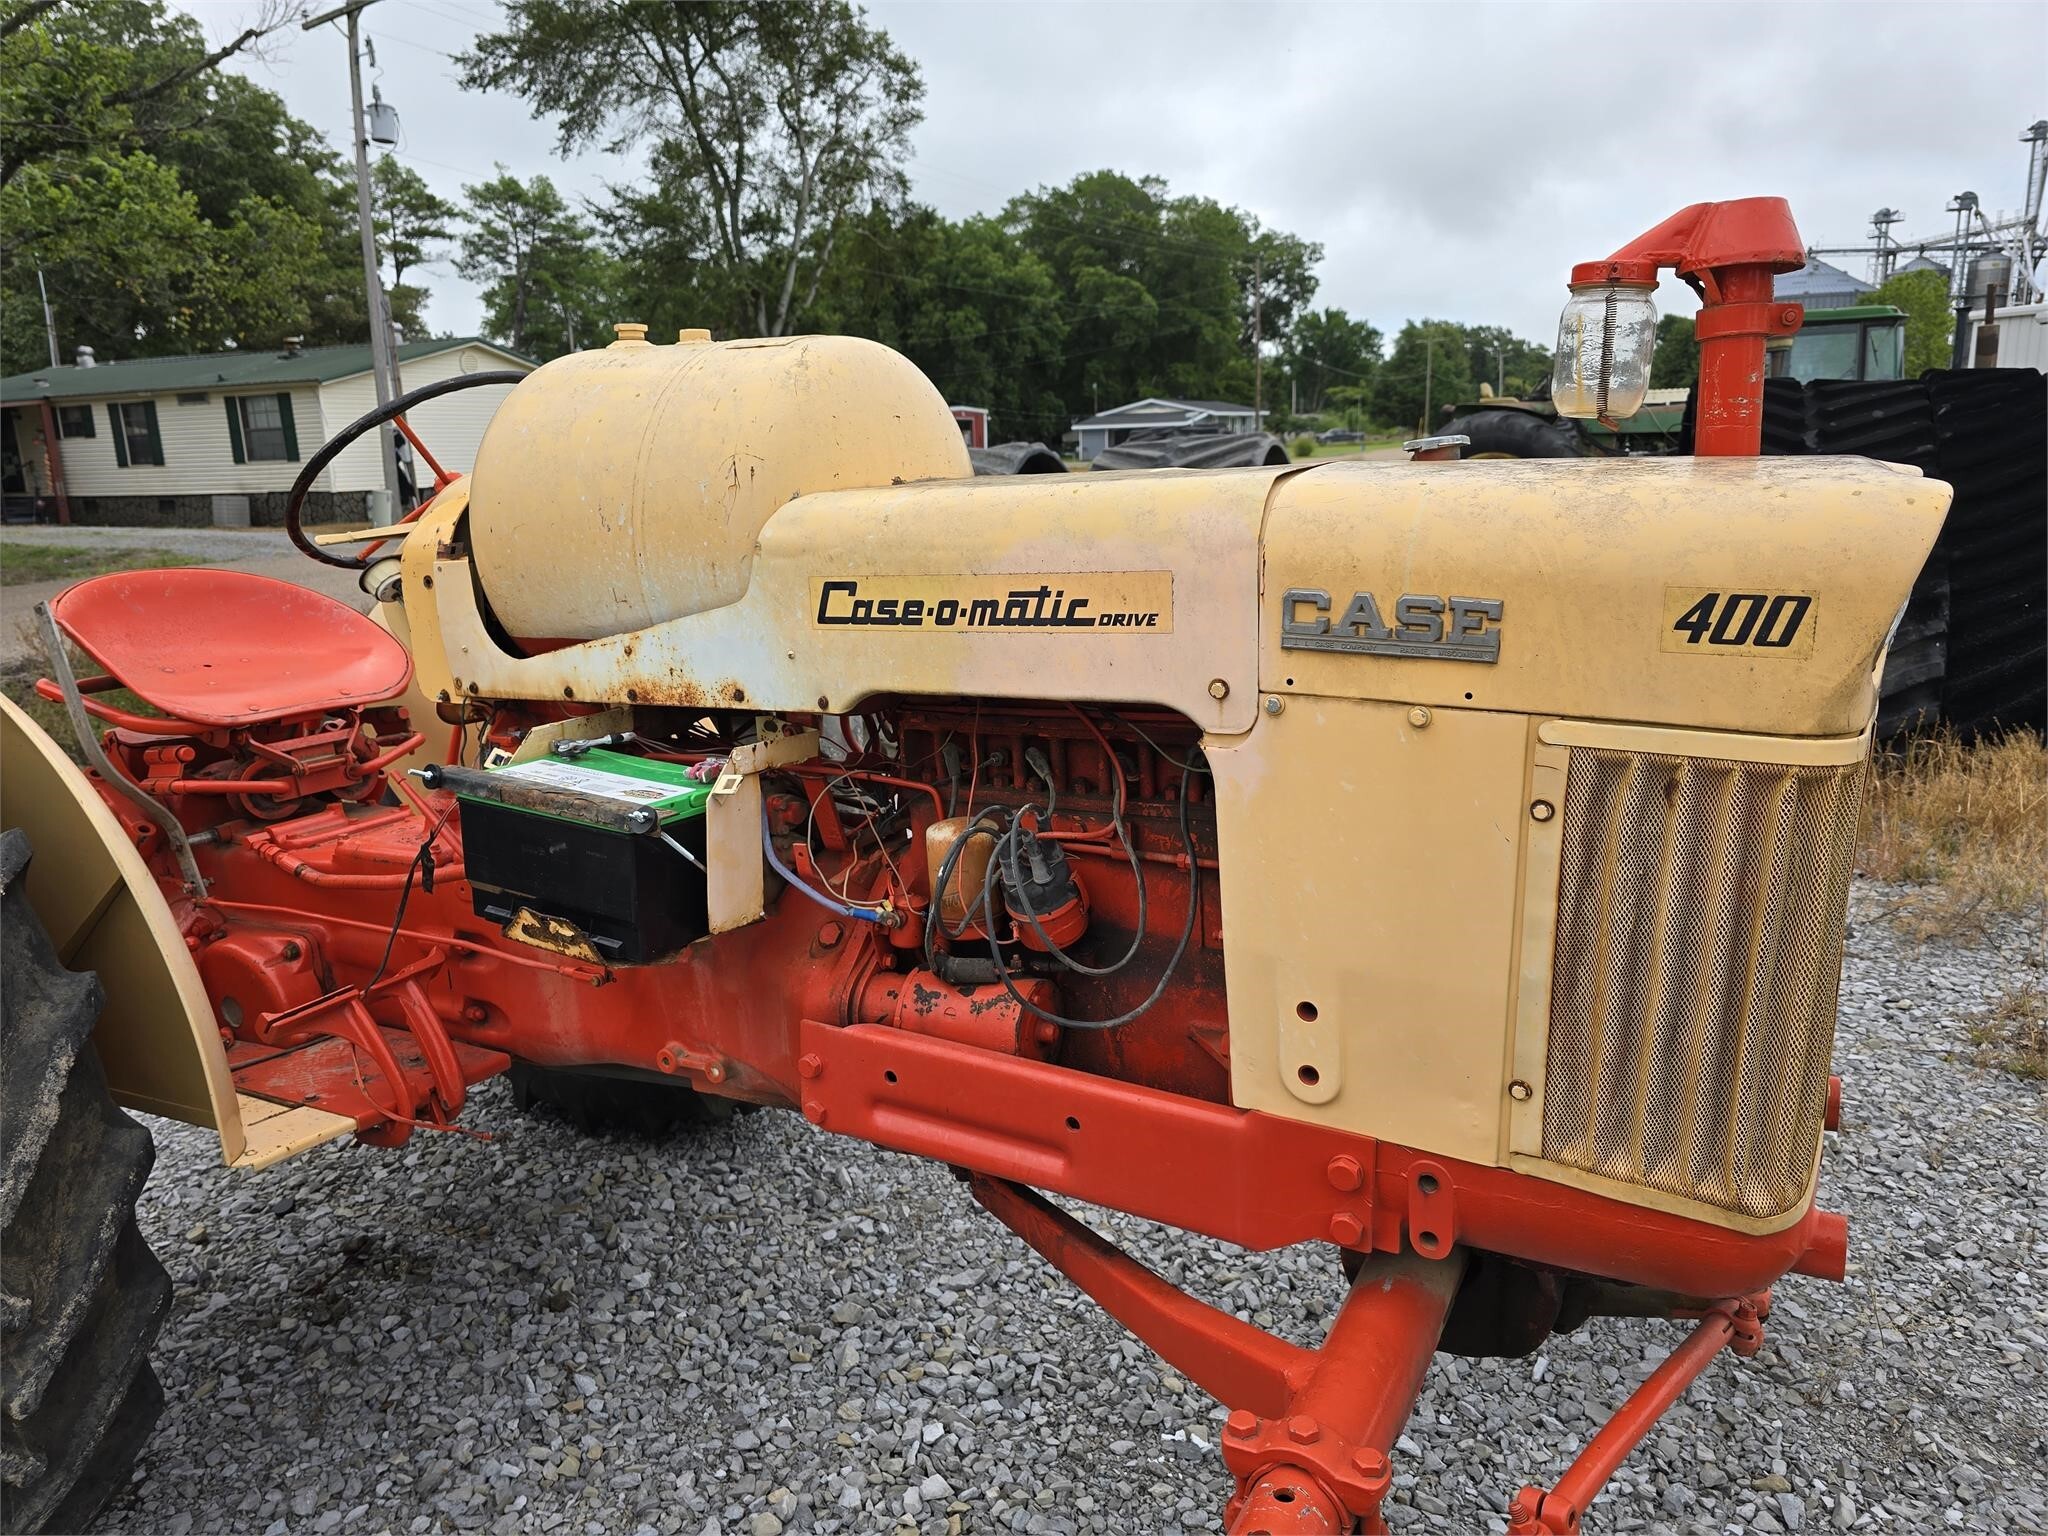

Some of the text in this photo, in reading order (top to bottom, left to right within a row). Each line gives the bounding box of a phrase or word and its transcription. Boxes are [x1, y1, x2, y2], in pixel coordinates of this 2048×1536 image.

[1098, 613, 1159, 627] DRIVE
[1282, 588, 1503, 645] CASE
[1673, 593, 1812, 648] 400
[1314, 641, 1335, 649] CASE
